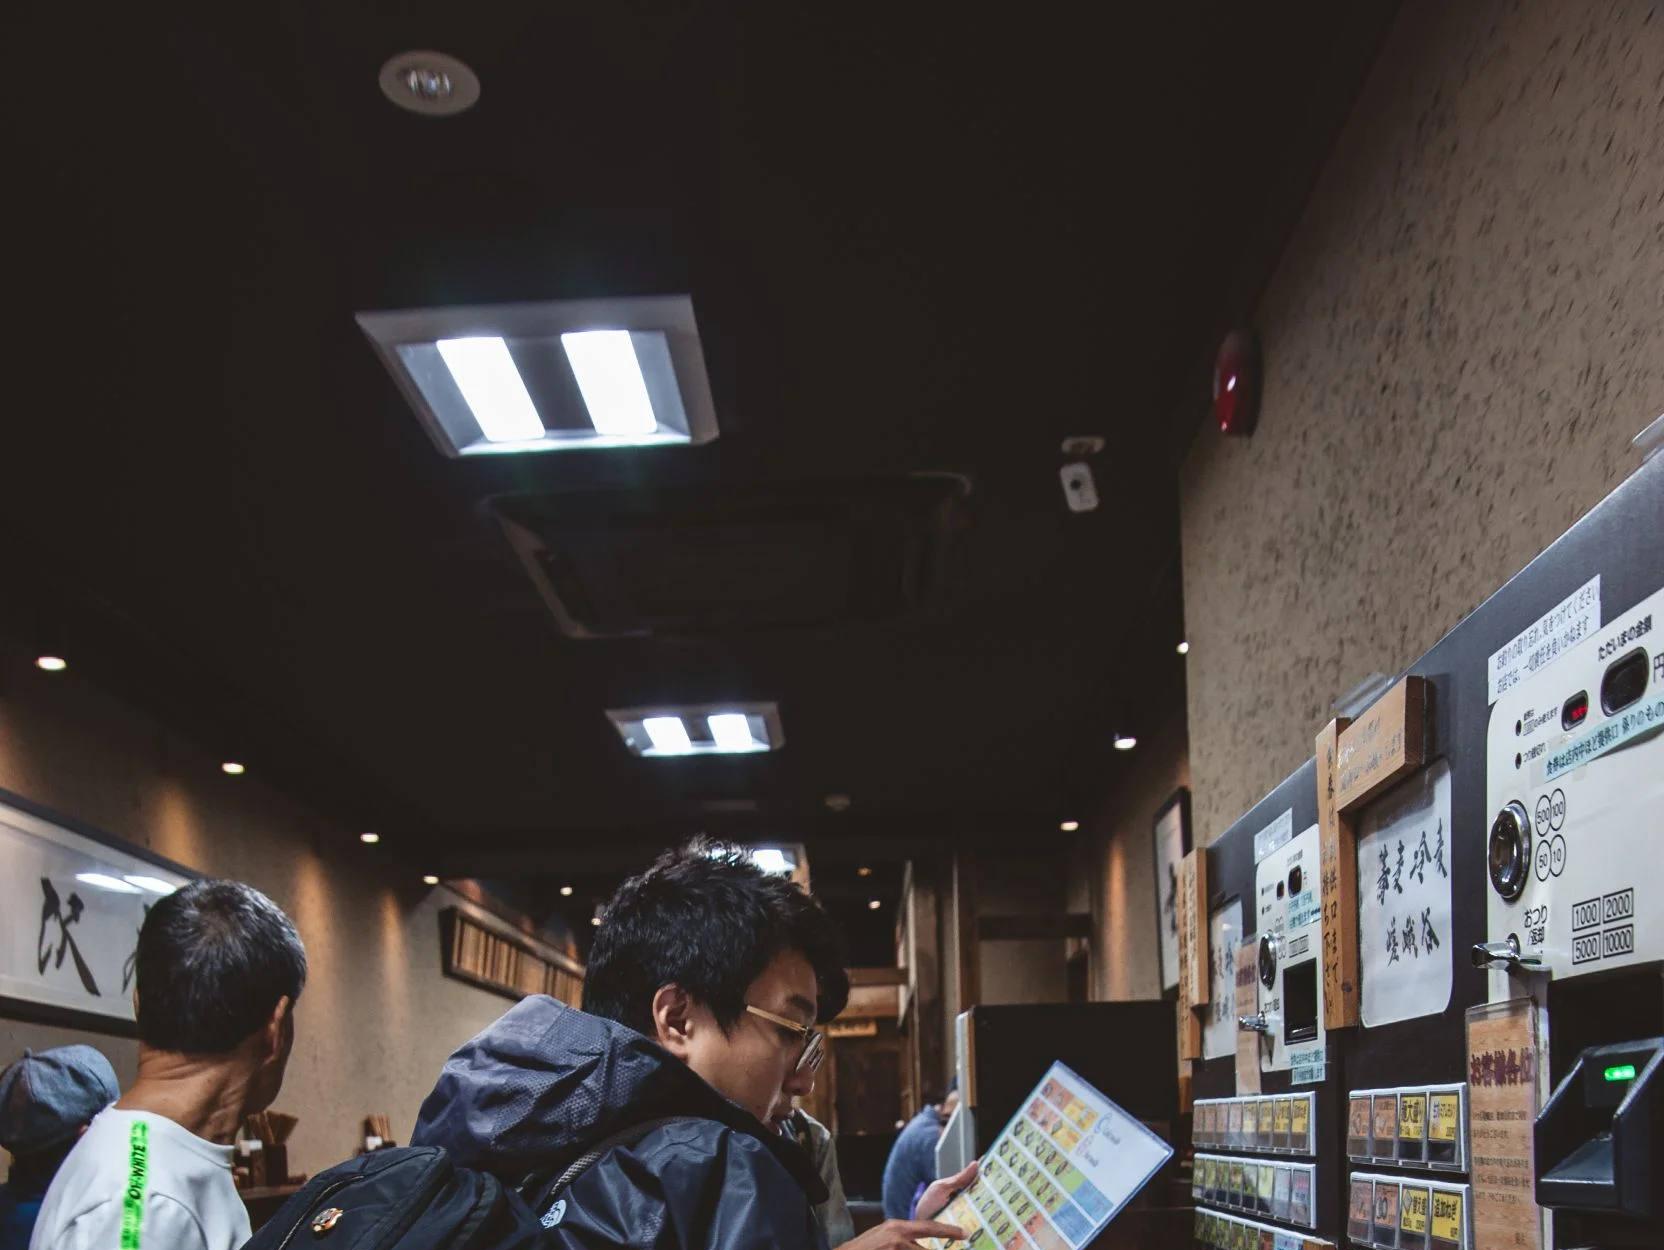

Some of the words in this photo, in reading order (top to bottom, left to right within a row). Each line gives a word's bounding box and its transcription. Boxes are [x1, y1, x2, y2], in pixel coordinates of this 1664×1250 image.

[1598, 613, 1653, 662] ただいまの金額
[1536, 807, 1551, 825] 500
[1551, 801, 1564, 817] 100
[1538, 853, 1548, 869] 50
[1553, 847, 1562, 863] 10
[1523, 904, 1548, 928] おつり
[1575, 904, 1598, 925] 1000
[1605, 894, 1630, 918] 2000
[1575, 938, 1598, 960] 5000
[1605, 929, 1632, 951] 10000
